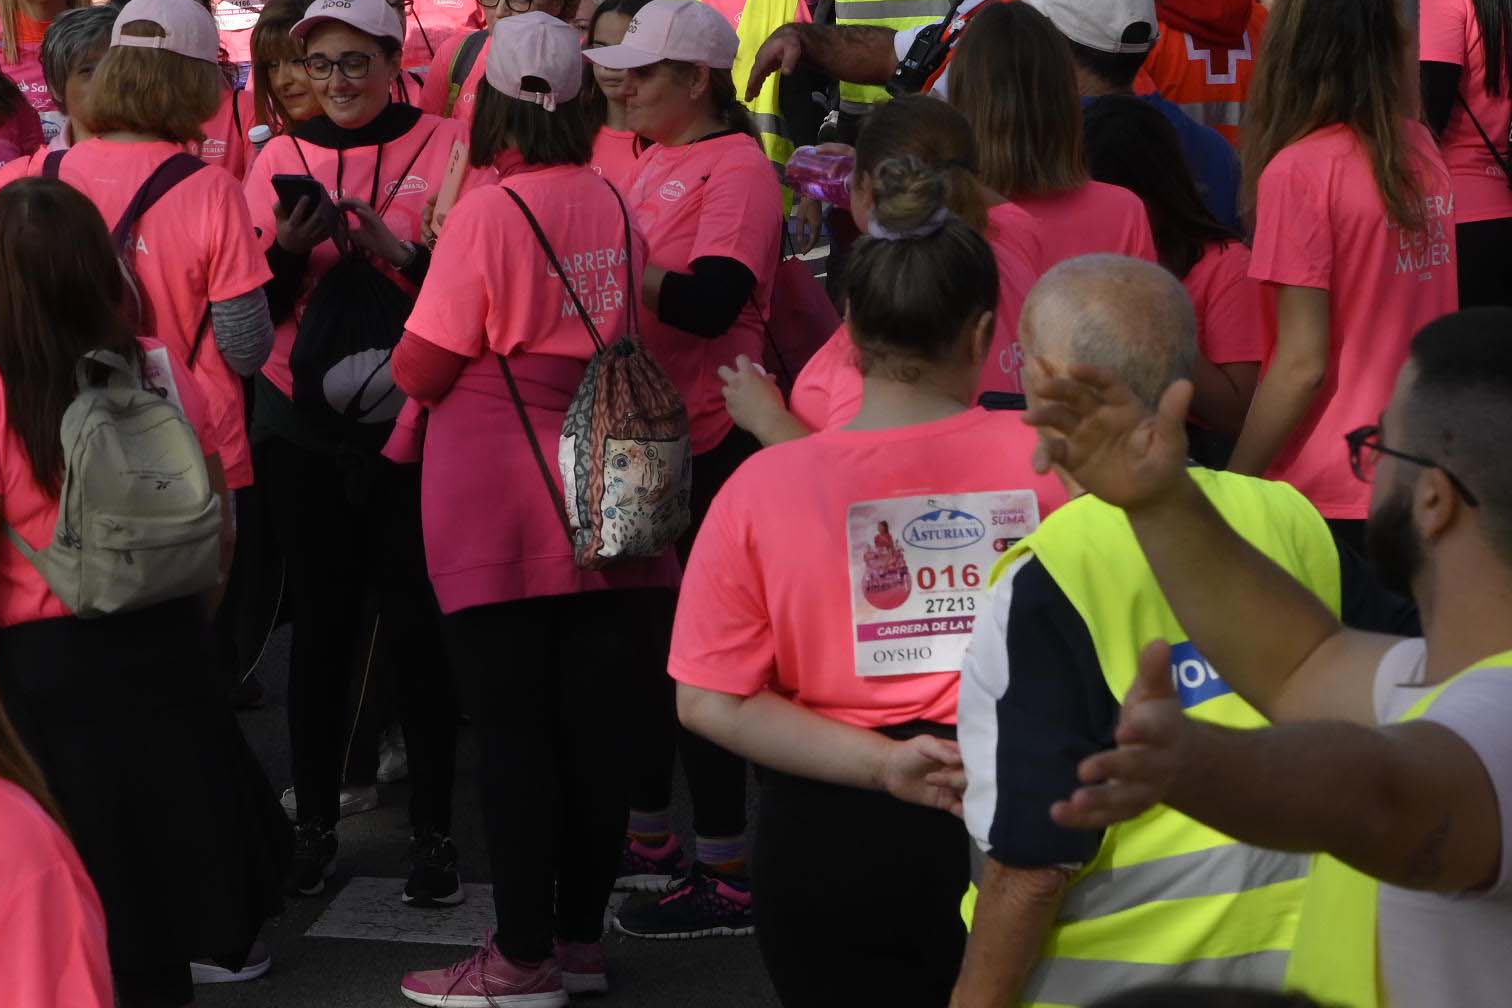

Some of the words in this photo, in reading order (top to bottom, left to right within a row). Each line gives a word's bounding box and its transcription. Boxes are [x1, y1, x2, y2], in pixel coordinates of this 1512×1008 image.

[595, 271, 619, 292] LA
[561, 290, 624, 319] MUJER
[991, 515, 1027, 527] SUMA
[909, 525, 981, 543] ASTURIANA
[916, 563, 982, 592] 016
[925, 596, 976, 614] 27213
[877, 622, 930, 637] CARRERA
[931, 622, 948, 632] DE
[950, 621, 965, 630] LA
[873, 646, 933, 665] OYSHO
